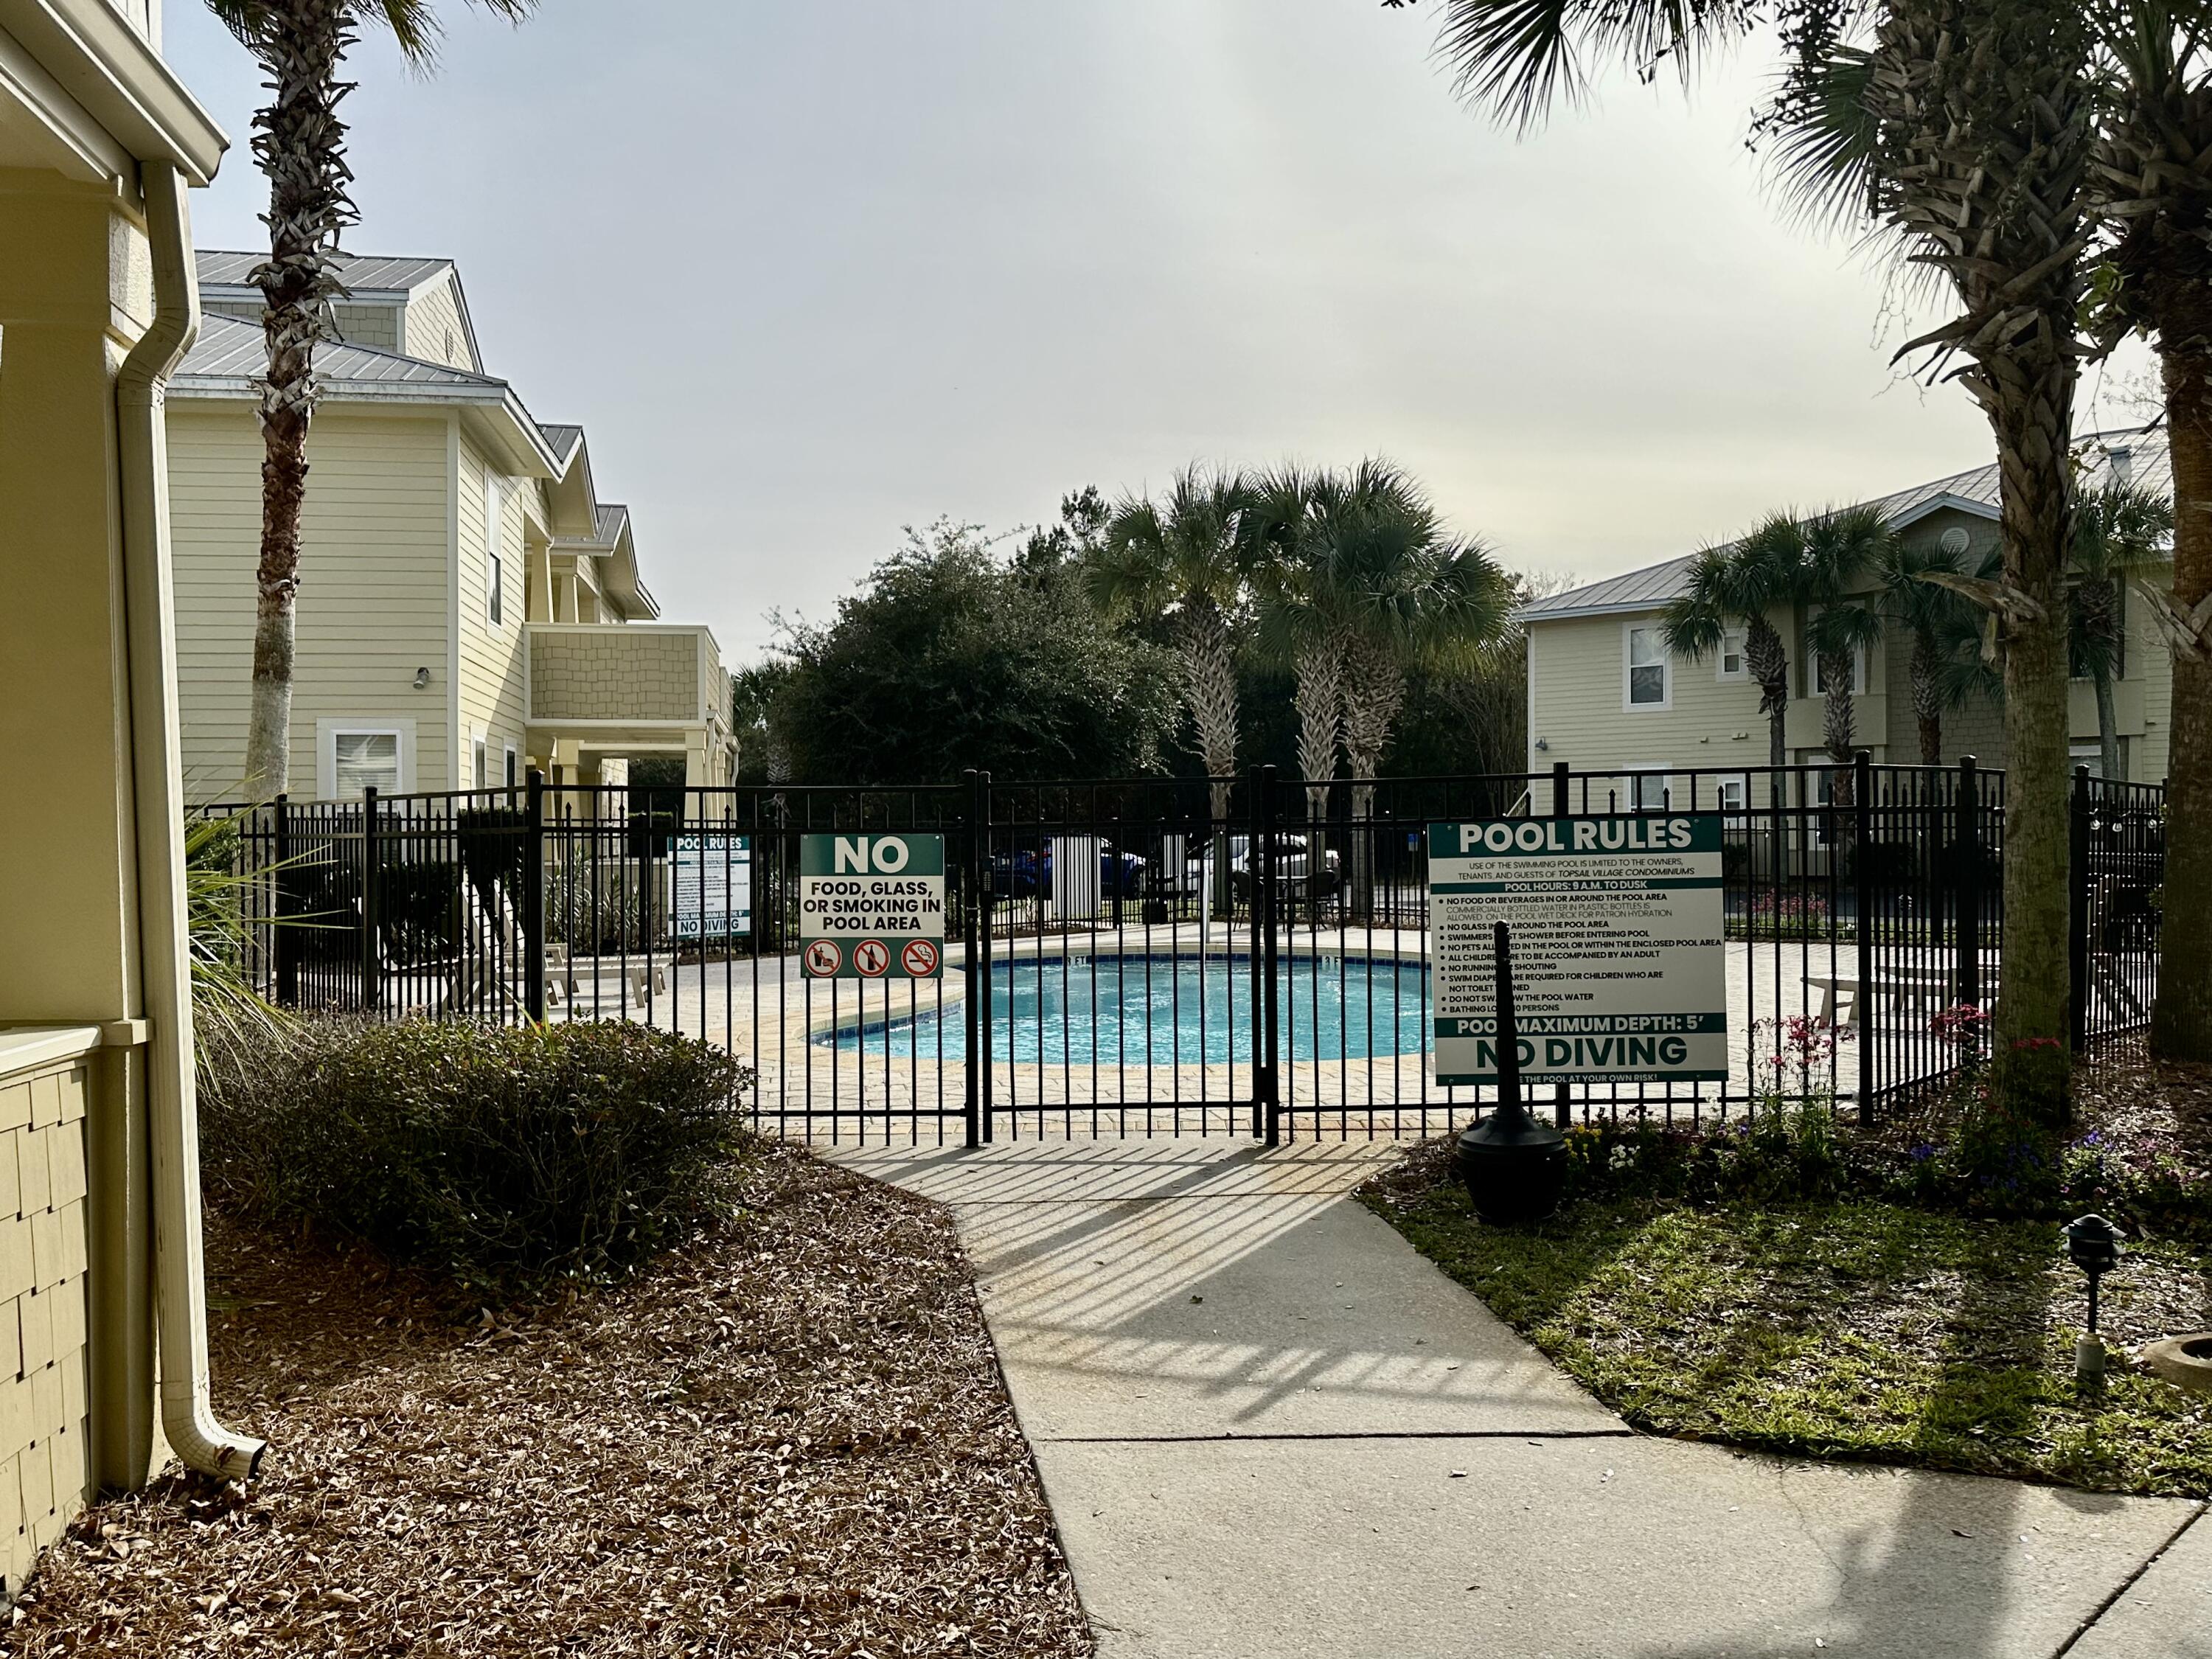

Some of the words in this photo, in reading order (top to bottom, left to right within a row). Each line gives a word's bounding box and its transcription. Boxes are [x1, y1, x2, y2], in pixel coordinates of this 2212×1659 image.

[1460, 821, 1565, 852] POOL
[1573, 818, 1692, 850] RULES
[677, 837, 707, 849] POOL
[835, 836, 909, 874] NO
[1513, 860, 1556, 869] SWIMMING
[1558, 860, 1579, 868] POOL
[1588, 859, 1618, 867] LIMITED
[1647, 858, 1683, 866] OWNERS,
[1559, 869, 1590, 877] TOPSAIL
[1593, 869, 1624, 877] VILLAGE
[1625, 867, 1695, 876] CONDOMINIUMS
[811, 881, 866, 897] FOOD,
[870, 881, 933, 898] GLASS,
[1505, 883, 1532, 891] POOL
[1533, 883, 1571, 891] HOURS:
[1573, 882, 1579, 890] 9
[1580, 881, 1603, 890] A.M.
[1604, 880, 1618, 889] TO
[1619, 880, 1648, 888] DUSK
[803, 899, 829, 913] OR
[832, 899, 919, 913] SMOKING
[922, 899, 941, 913] IN
[1498, 896, 1545, 904] BEVERAGES
[1446, 905, 1505, 914] COMMERCIALLY
[1579, 902, 1608, 911] PLASTIC
[1447, 914, 1482, 922] ALLOWED
[1628, 909, 1672, 917] HYDRATION
[681, 921, 698, 932] NO
[823, 917, 870, 931] POOL
[874, 917, 922, 930] AREA
[1587, 930, 1626, 938] ENTERING
[1632, 939, 1674, 947] ENCLOSED
[1545, 951, 1607, 959] ACCOMPANIED
[1457, 1019, 1498, 1034] POO
[1514, 1018, 1610, 1032] MAXIMUM
[1615, 1015, 1682, 1032] DEPTH:
[1477, 1038, 1536, 1068] NO
[1545, 1036, 1688, 1068] DIVING
[1543, 1075, 1567, 1083] POOL
[1582, 1074, 1607, 1082] YOUR
[1634, 1074, 1658, 1082] RISK!
